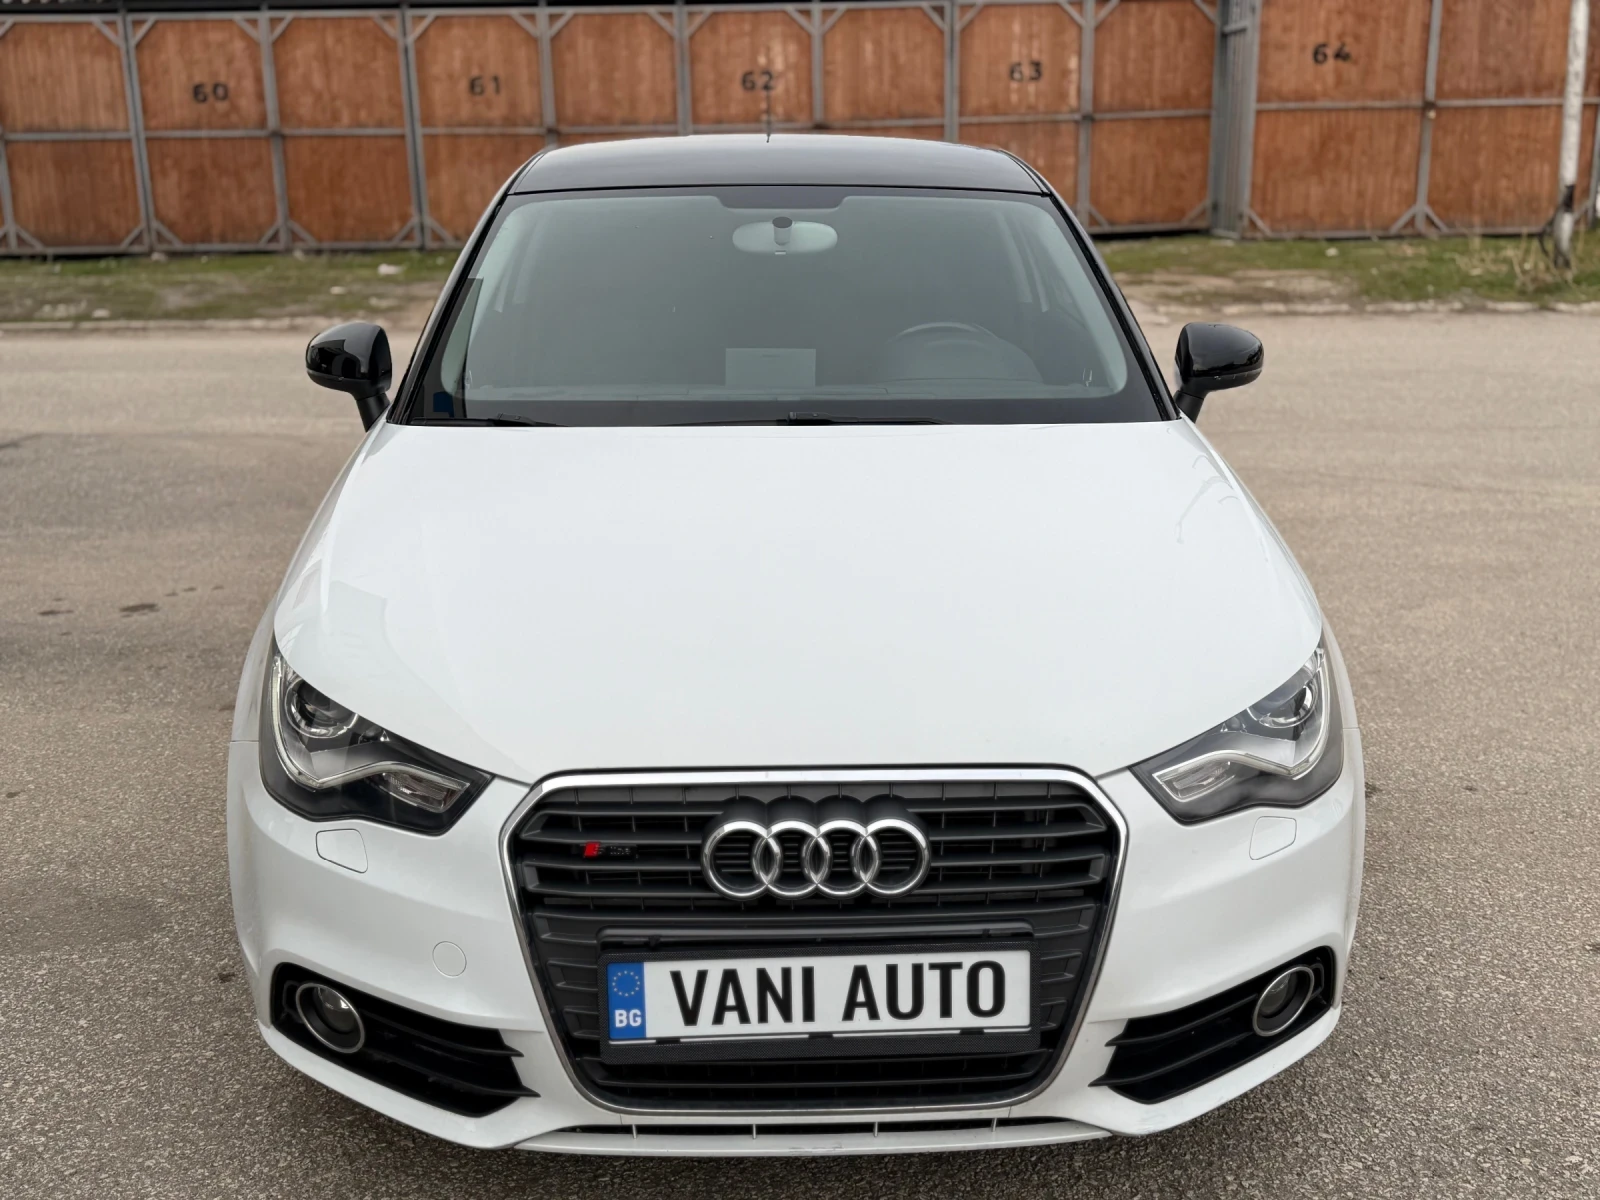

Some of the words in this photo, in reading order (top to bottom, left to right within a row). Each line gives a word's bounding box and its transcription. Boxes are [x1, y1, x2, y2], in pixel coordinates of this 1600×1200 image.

[1313, 42, 1351, 65] 64
[742, 70, 774, 91] 62
[1009, 60, 1042, 81] 63
[193, 82, 229, 103] 60
[469, 75, 500, 96] 61
[669, 966, 815, 1027] VANI
[841, 960, 1006, 1022] AUTO
[615, 1009, 642, 1028] BG
